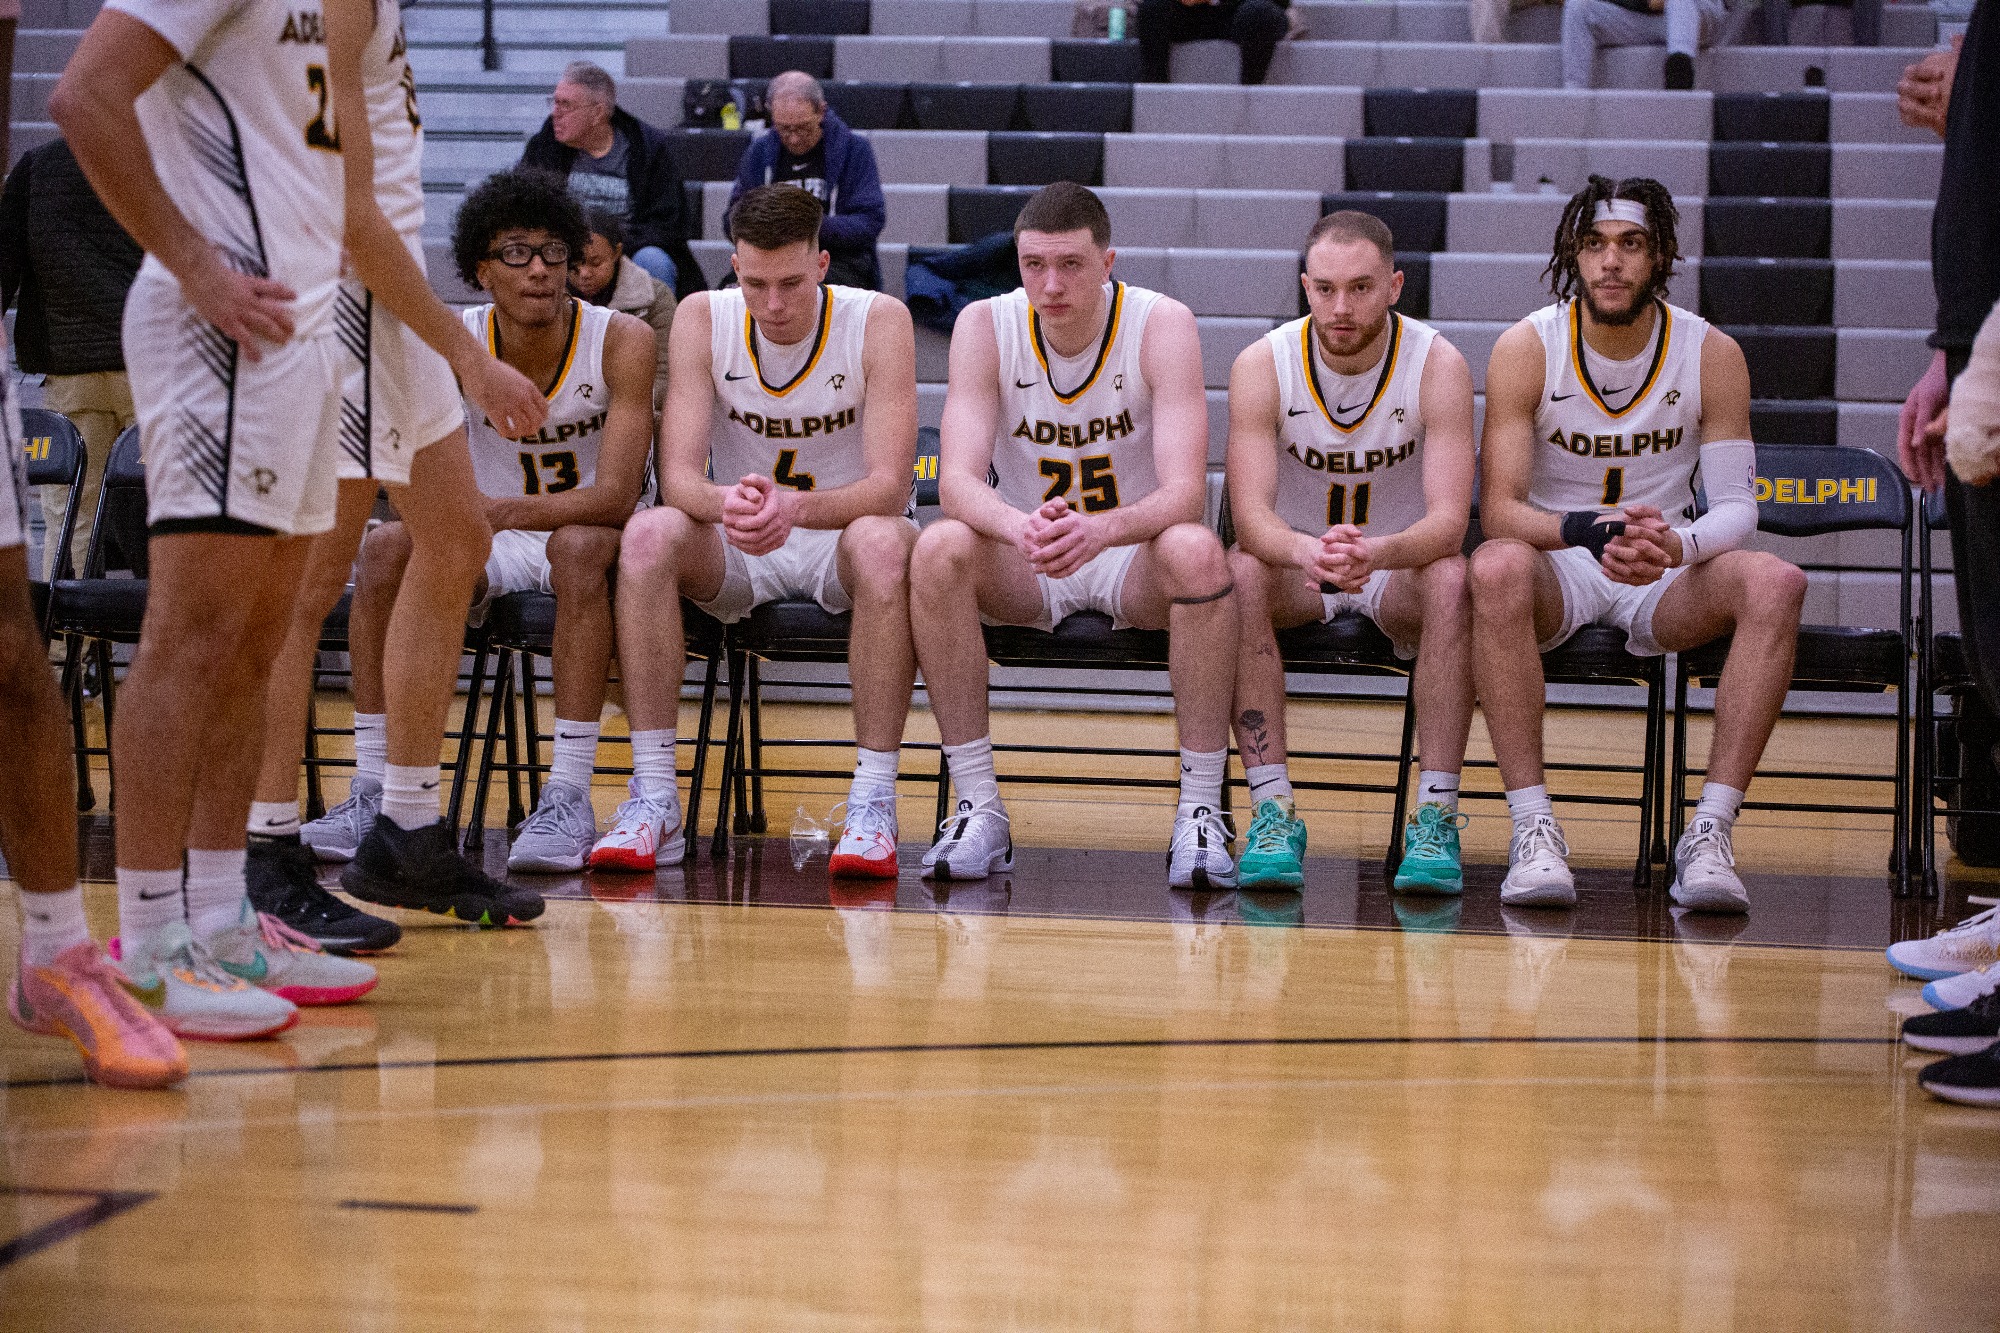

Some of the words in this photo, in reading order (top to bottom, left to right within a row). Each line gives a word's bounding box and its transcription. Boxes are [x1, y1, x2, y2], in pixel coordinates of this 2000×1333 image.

[728, 406, 855, 439] ADELPHI
[1011, 408, 1136, 449] ADELPHI
[1549, 426, 1684, 458] ADELPHI
[518, 451, 581, 495] 13
[773, 449, 816, 492] 4
[1286, 438, 1416, 475] ADELPHI
[1038, 453, 1121, 515] 25
[1327, 481, 1371, 526] 11
[1600, 466, 1625, 508] 1
[1755, 476, 1877, 504] DELPHI
